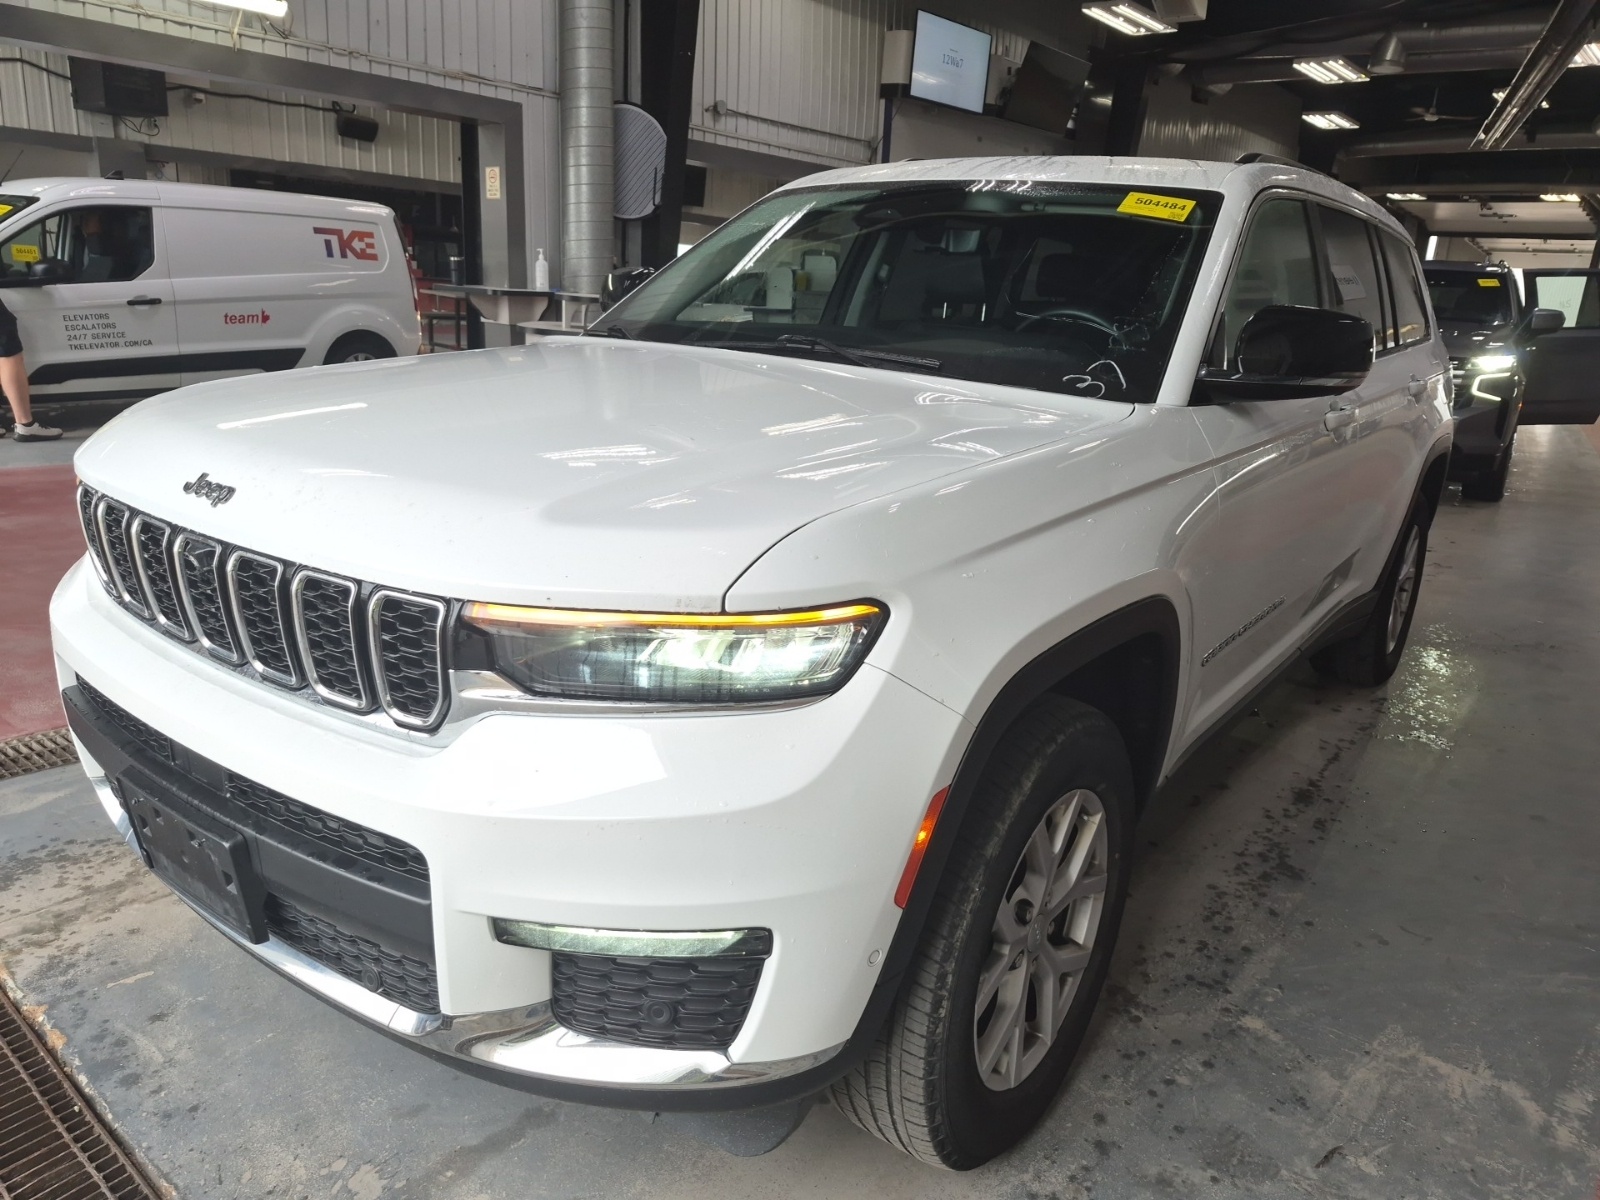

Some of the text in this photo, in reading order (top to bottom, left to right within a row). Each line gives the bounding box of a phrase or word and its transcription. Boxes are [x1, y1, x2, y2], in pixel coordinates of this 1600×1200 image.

[1135, 197, 1187, 211] 504484
[312, 226, 379, 261] TKE
[62, 313, 110, 322] ELEVATORS
[223, 311, 260, 325] team
[64, 322, 117, 331] ESCALATORS
[67, 331, 126, 341] 24/7 SERVICE
[68, 339, 153, 351] TKELEVATOR.COM/CA
[182, 472, 237, 508] Jeep
